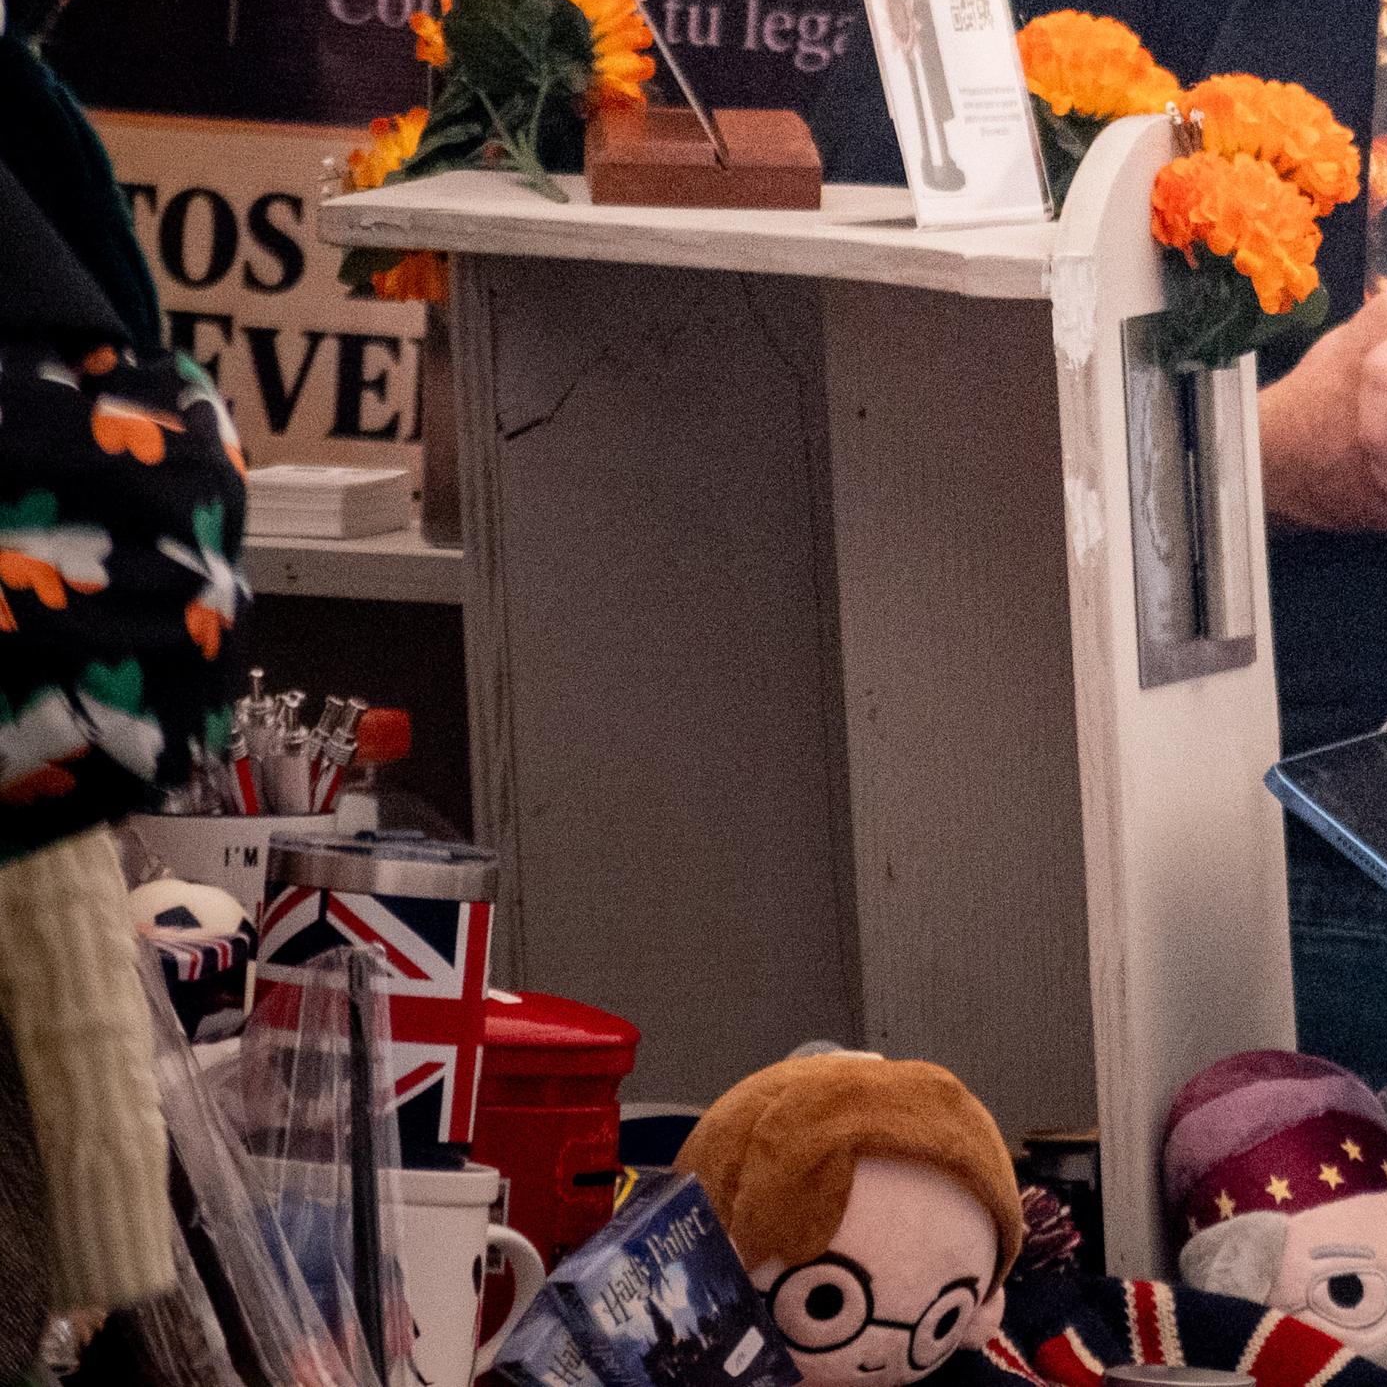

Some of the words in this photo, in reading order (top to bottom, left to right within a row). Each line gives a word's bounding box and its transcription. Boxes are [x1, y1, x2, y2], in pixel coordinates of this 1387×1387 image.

[224, 845, 259, 868] I'M
[599, 1254, 654, 1328] Harry
[646, 1204, 708, 1287] Potter
